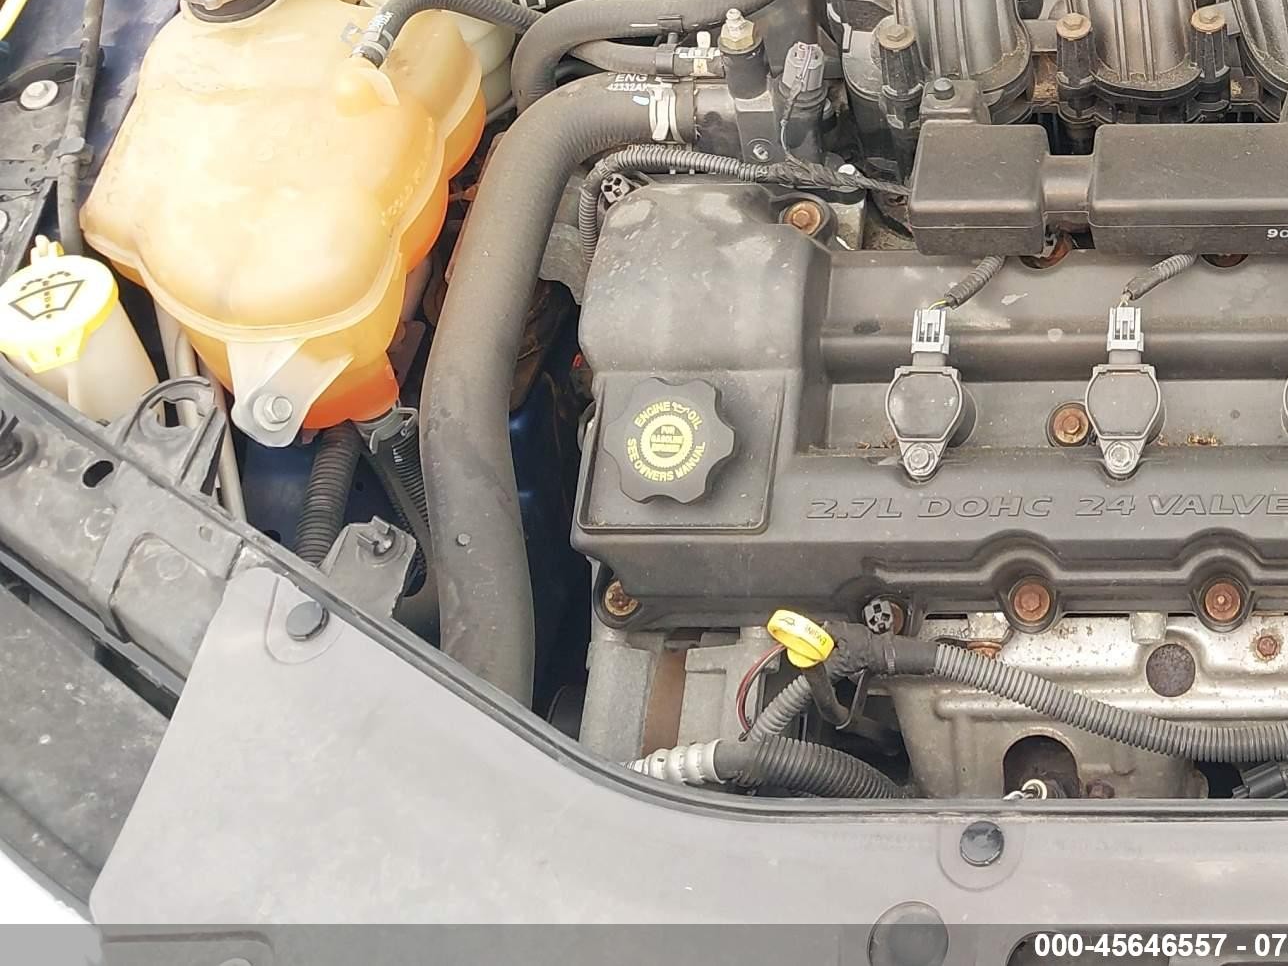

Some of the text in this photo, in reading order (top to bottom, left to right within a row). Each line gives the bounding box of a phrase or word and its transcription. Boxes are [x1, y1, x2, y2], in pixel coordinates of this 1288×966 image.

[633, 401, 703, 431] ENGINE OIL
[626, 437, 706, 482] SEE OWNERS MANUAL
[806, 496, 902, 519] 2.7L
[917, 495, 1054, 519] DOHC
[1075, 494, 1137, 517] 24
